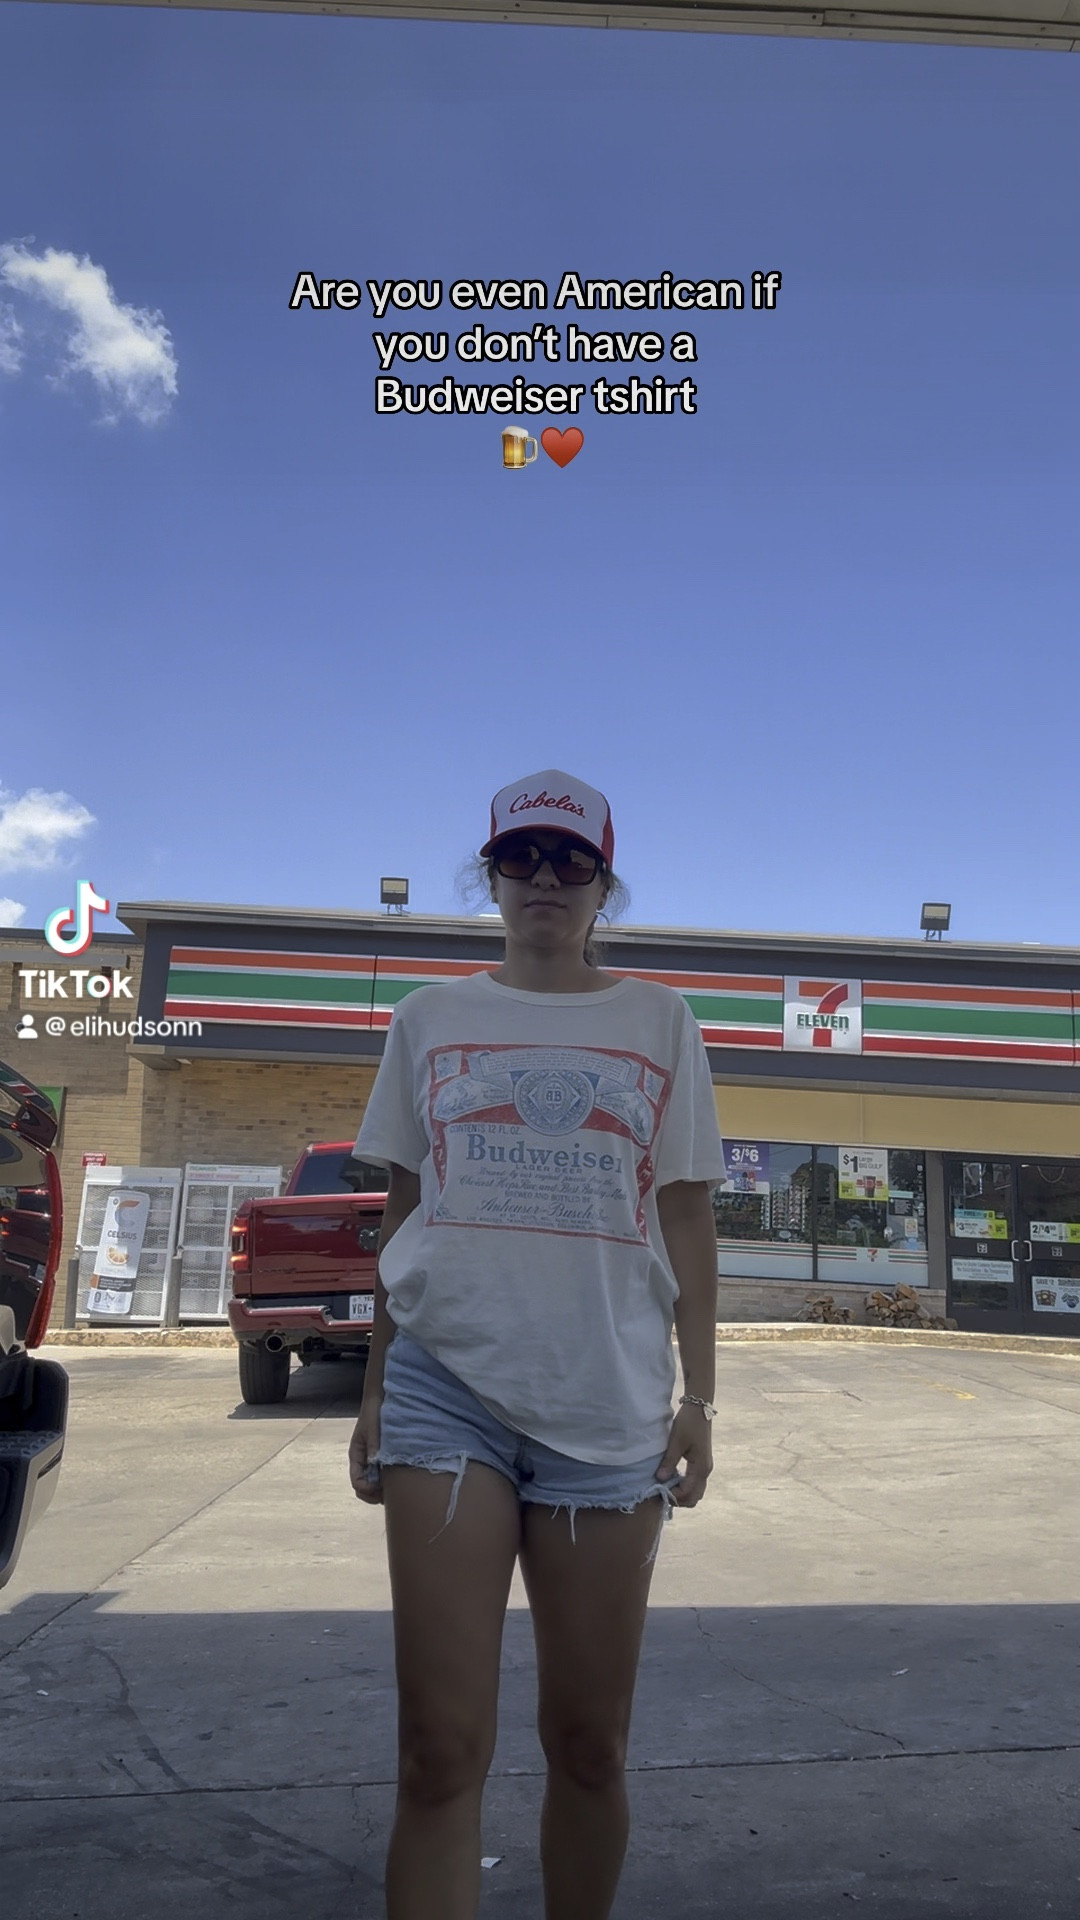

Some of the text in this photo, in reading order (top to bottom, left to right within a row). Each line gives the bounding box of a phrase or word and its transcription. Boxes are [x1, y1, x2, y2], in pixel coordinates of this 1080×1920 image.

[488, 1125, 496, 1134] 12
[843, 1154, 859, 1173] $1
[107, 1230, 137, 1240] CELSIUS
